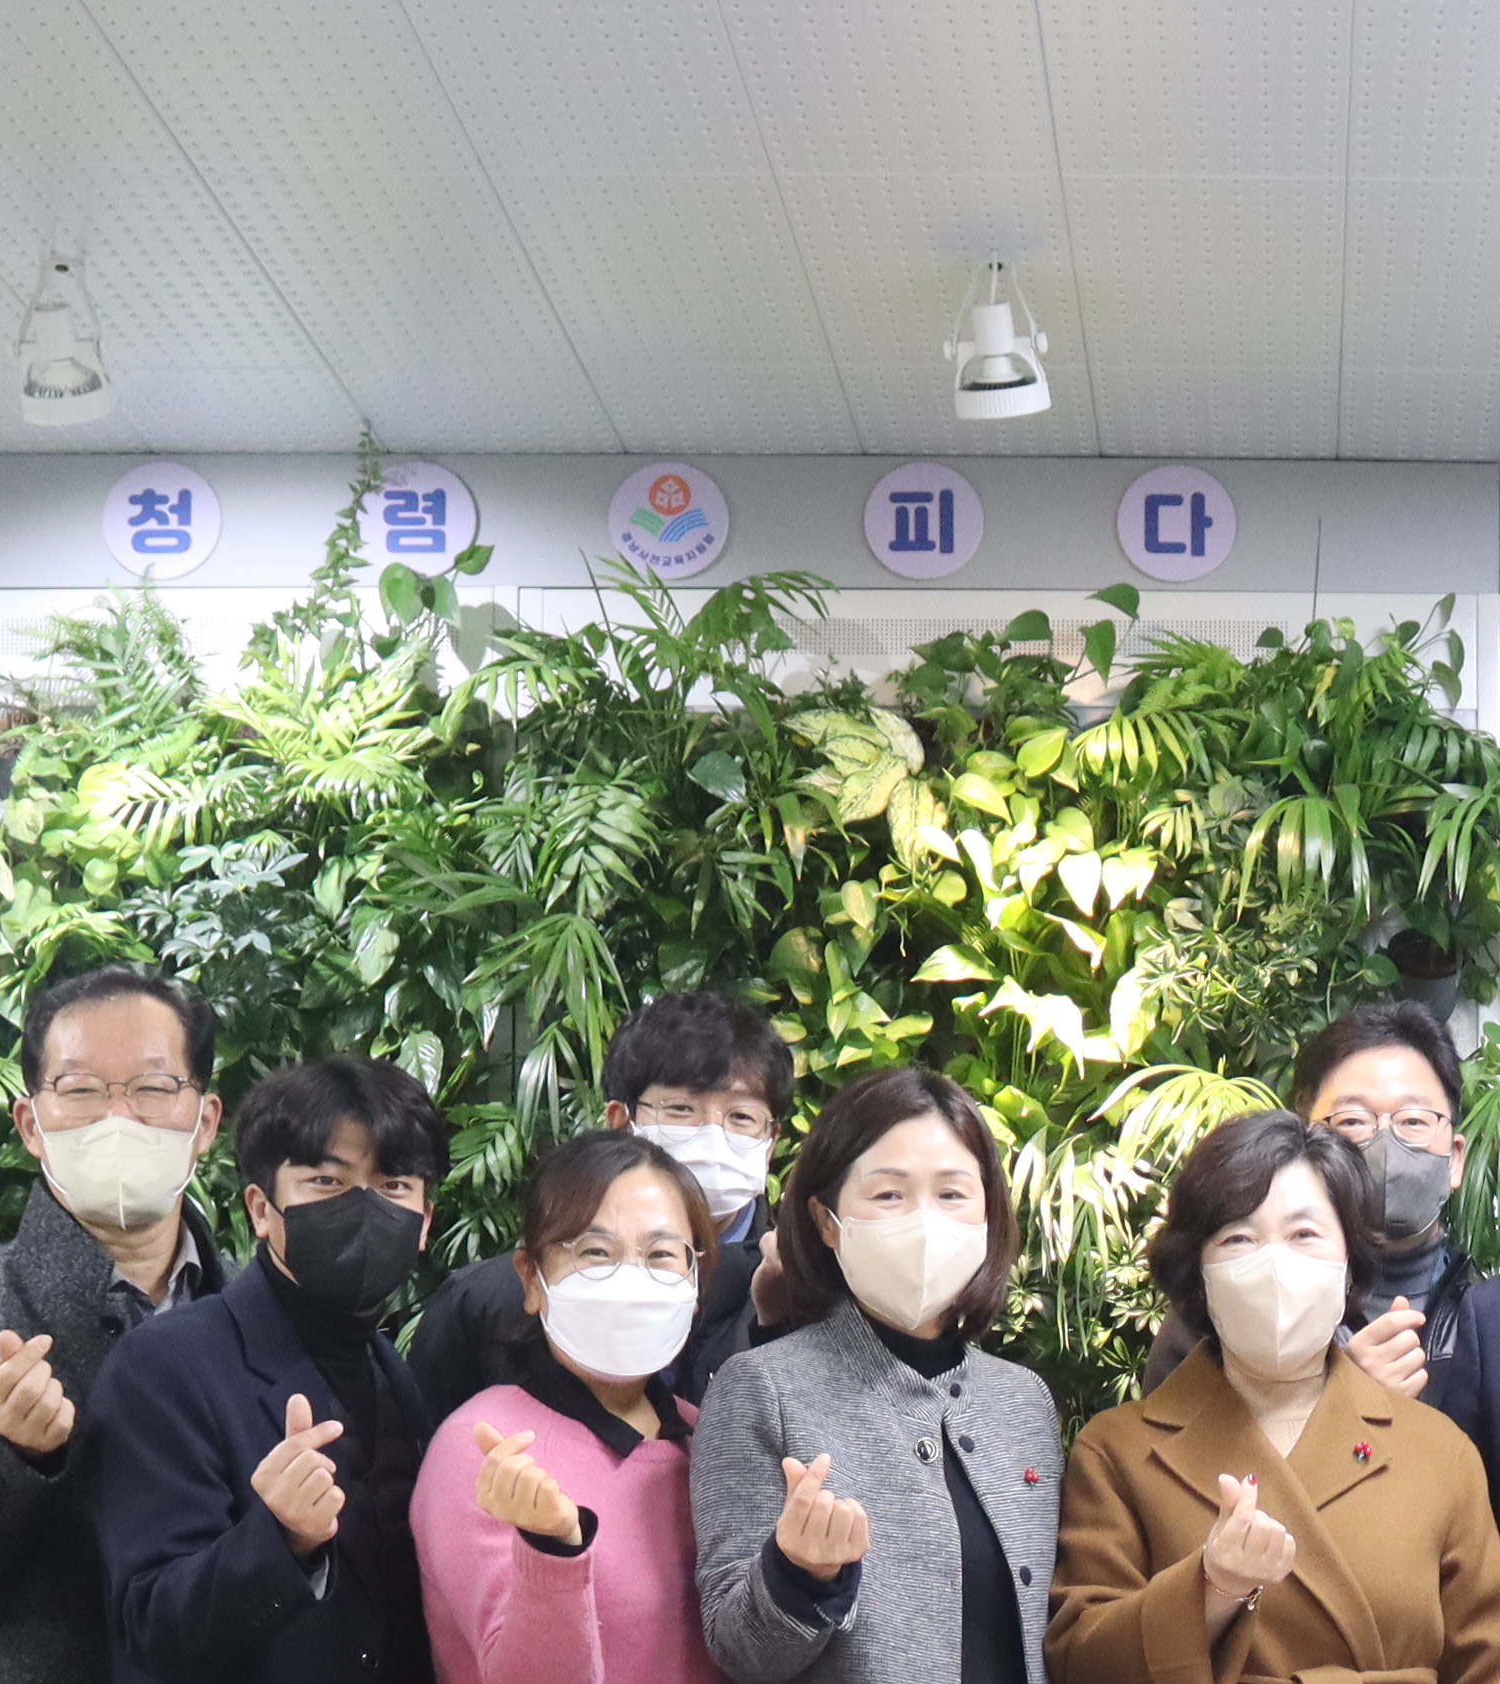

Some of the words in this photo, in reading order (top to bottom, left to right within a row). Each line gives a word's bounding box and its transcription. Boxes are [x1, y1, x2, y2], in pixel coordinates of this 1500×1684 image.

[127, 488, 192, 555] 청
[385, 487, 450, 554] 렴
[887, 488, 953, 556] 피
[1143, 490, 1213, 554] 다
